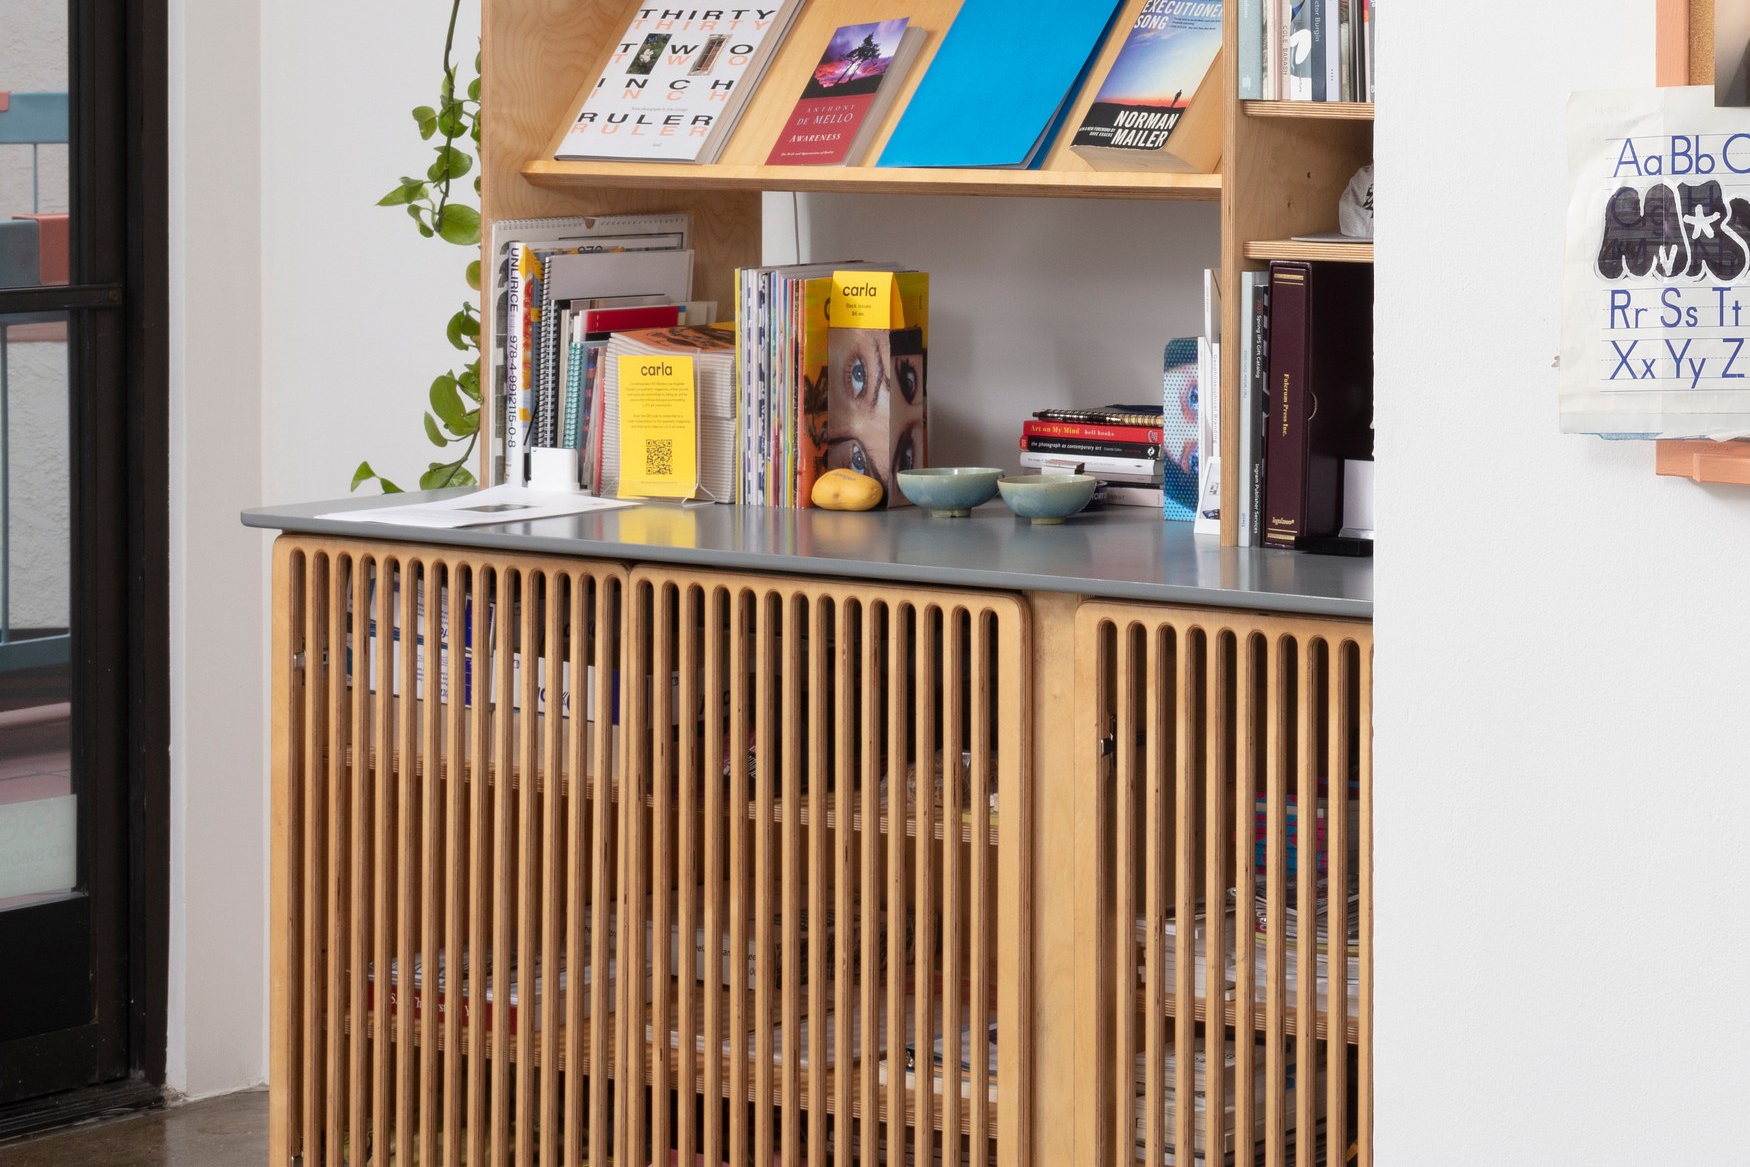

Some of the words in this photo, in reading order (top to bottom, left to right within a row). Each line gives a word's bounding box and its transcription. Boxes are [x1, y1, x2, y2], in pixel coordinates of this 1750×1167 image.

[640, 9, 776, 20] THIRTY
[1134, 14, 1169, 30] SONG
[1313, 17, 1321, 42] Burgin
[807, 104, 856, 113] ANTHONY
[576, 112, 714, 126] RULER
[797, 118, 809, 126] DE
[813, 113, 854, 125] MELLO
[1113, 110, 1179, 130] NORMAN
[789, 133, 841, 143] AWARENESS
[1111, 129, 1168, 148] MAILER
[1613, 139, 1662, 178] Aa
[1670, 135, 1715, 175] Bb
[509, 247, 520, 312] UNLIRICE
[842, 282, 877, 297] carla
[1610, 289, 1648, 329] Rr
[1660, 287, 1698, 328] Ss
[1712, 287, 1741, 327] Tt
[640, 361, 673, 376] carla
[1610, 340, 1656, 380] Xx
[1665, 339, 1706, 389] Yy
[508, 335, 519, 448] 978-4-9912115-0-8
[1052, 426, 1061, 435] My
[1098, 429, 1115, 437] hooks
[1039, 441, 1061, 450] photograph
[1067, 444, 1094, 452] contemporary
